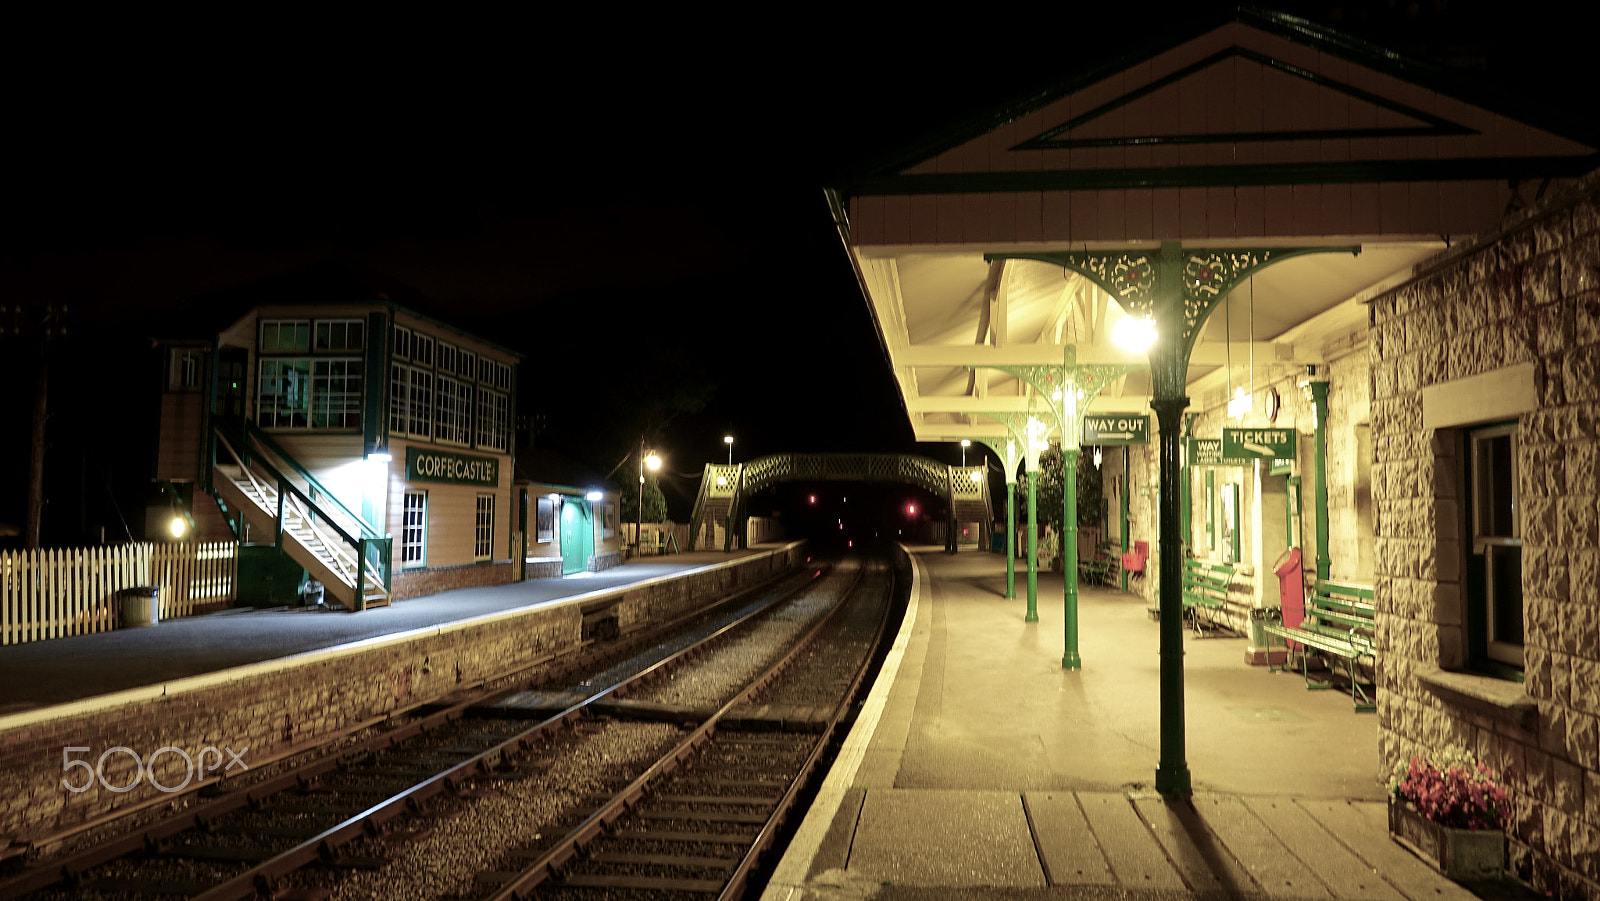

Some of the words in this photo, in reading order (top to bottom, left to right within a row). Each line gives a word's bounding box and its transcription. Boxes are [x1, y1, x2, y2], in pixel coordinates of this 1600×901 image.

[1087, 418, 1115, 432] WAY
[1117, 418, 1144, 432] OUT
[1230, 431, 1288, 445] TICKETS
[1197, 440, 1220, 451] WAY
[416, 454, 453, 479] CORFE
[455, 459, 492, 481] CASTLE
